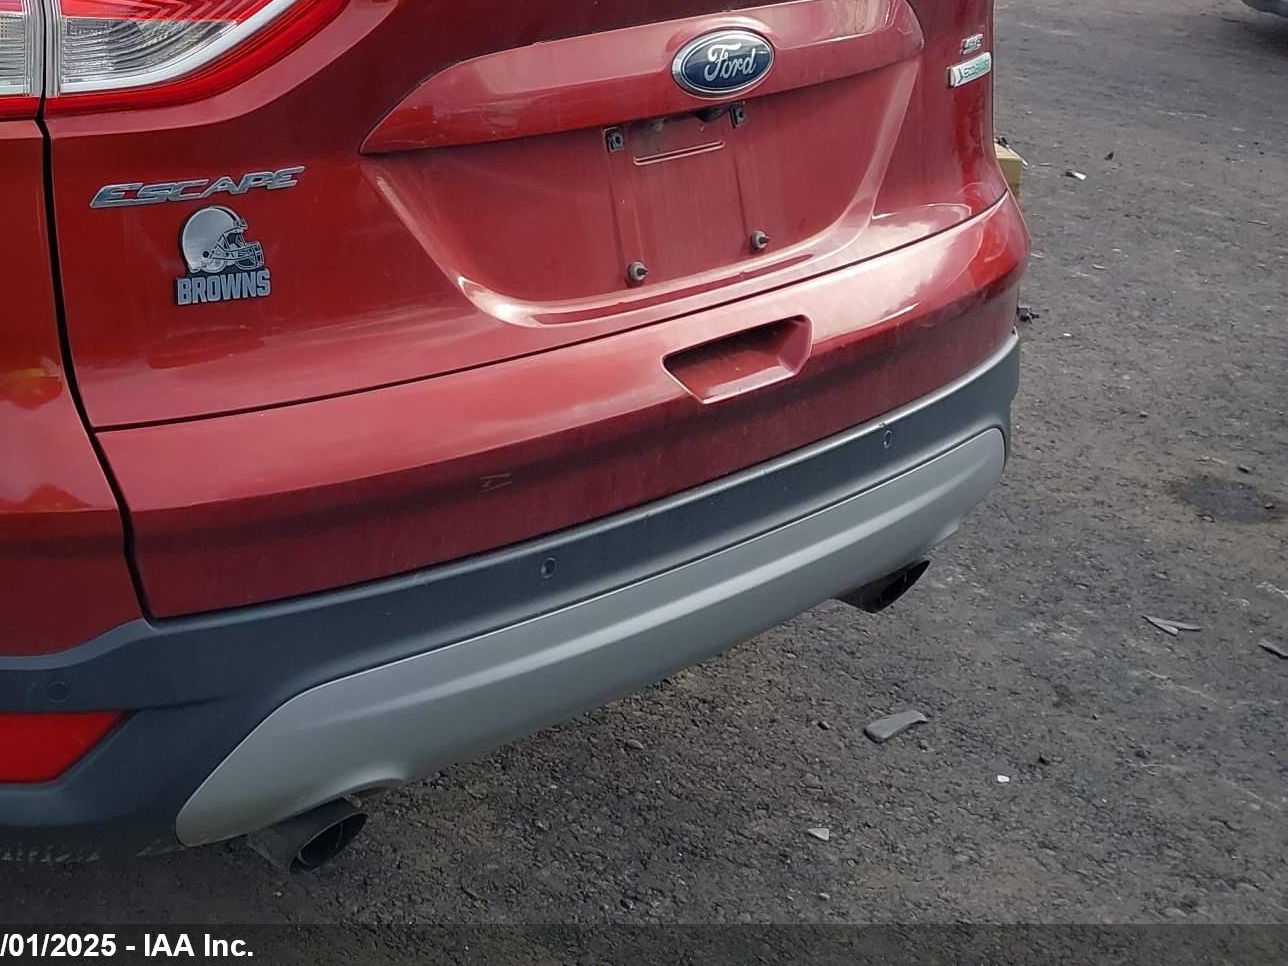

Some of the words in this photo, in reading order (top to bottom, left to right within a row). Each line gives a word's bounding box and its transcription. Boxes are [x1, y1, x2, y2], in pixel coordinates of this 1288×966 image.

[704, 42, 757, 82] Ford
[89, 165, 305, 209] ESCAPE
[176, 268, 272, 306] BROWNS
